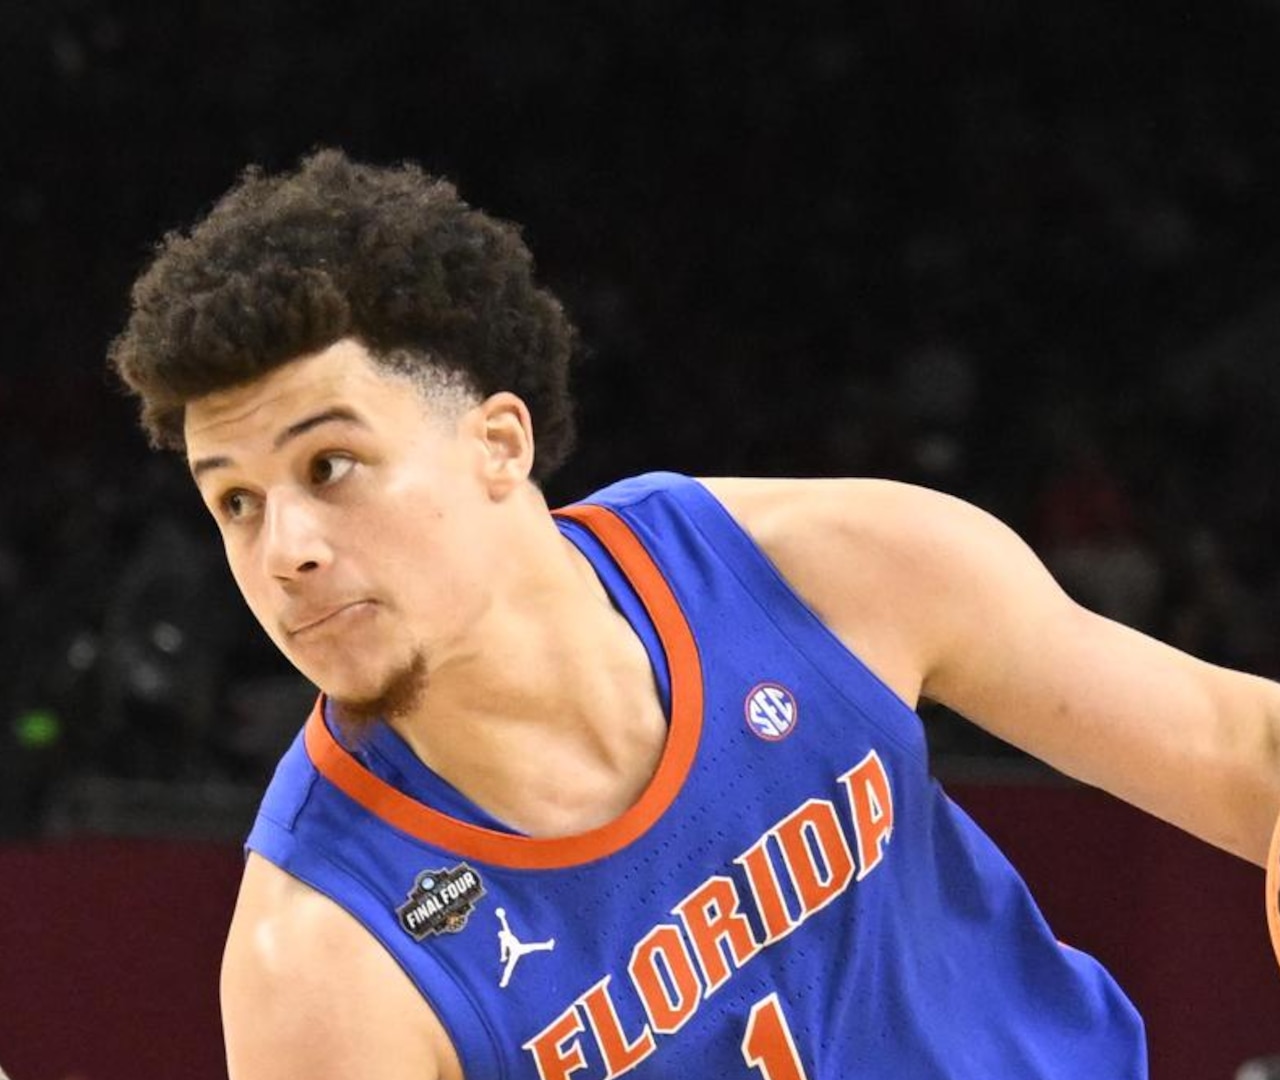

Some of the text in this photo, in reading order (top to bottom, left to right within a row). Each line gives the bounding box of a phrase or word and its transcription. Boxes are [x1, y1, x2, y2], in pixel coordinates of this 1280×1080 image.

[749, 687, 793, 737] SEC
[406, 871, 476, 929] FINAL FOUR
